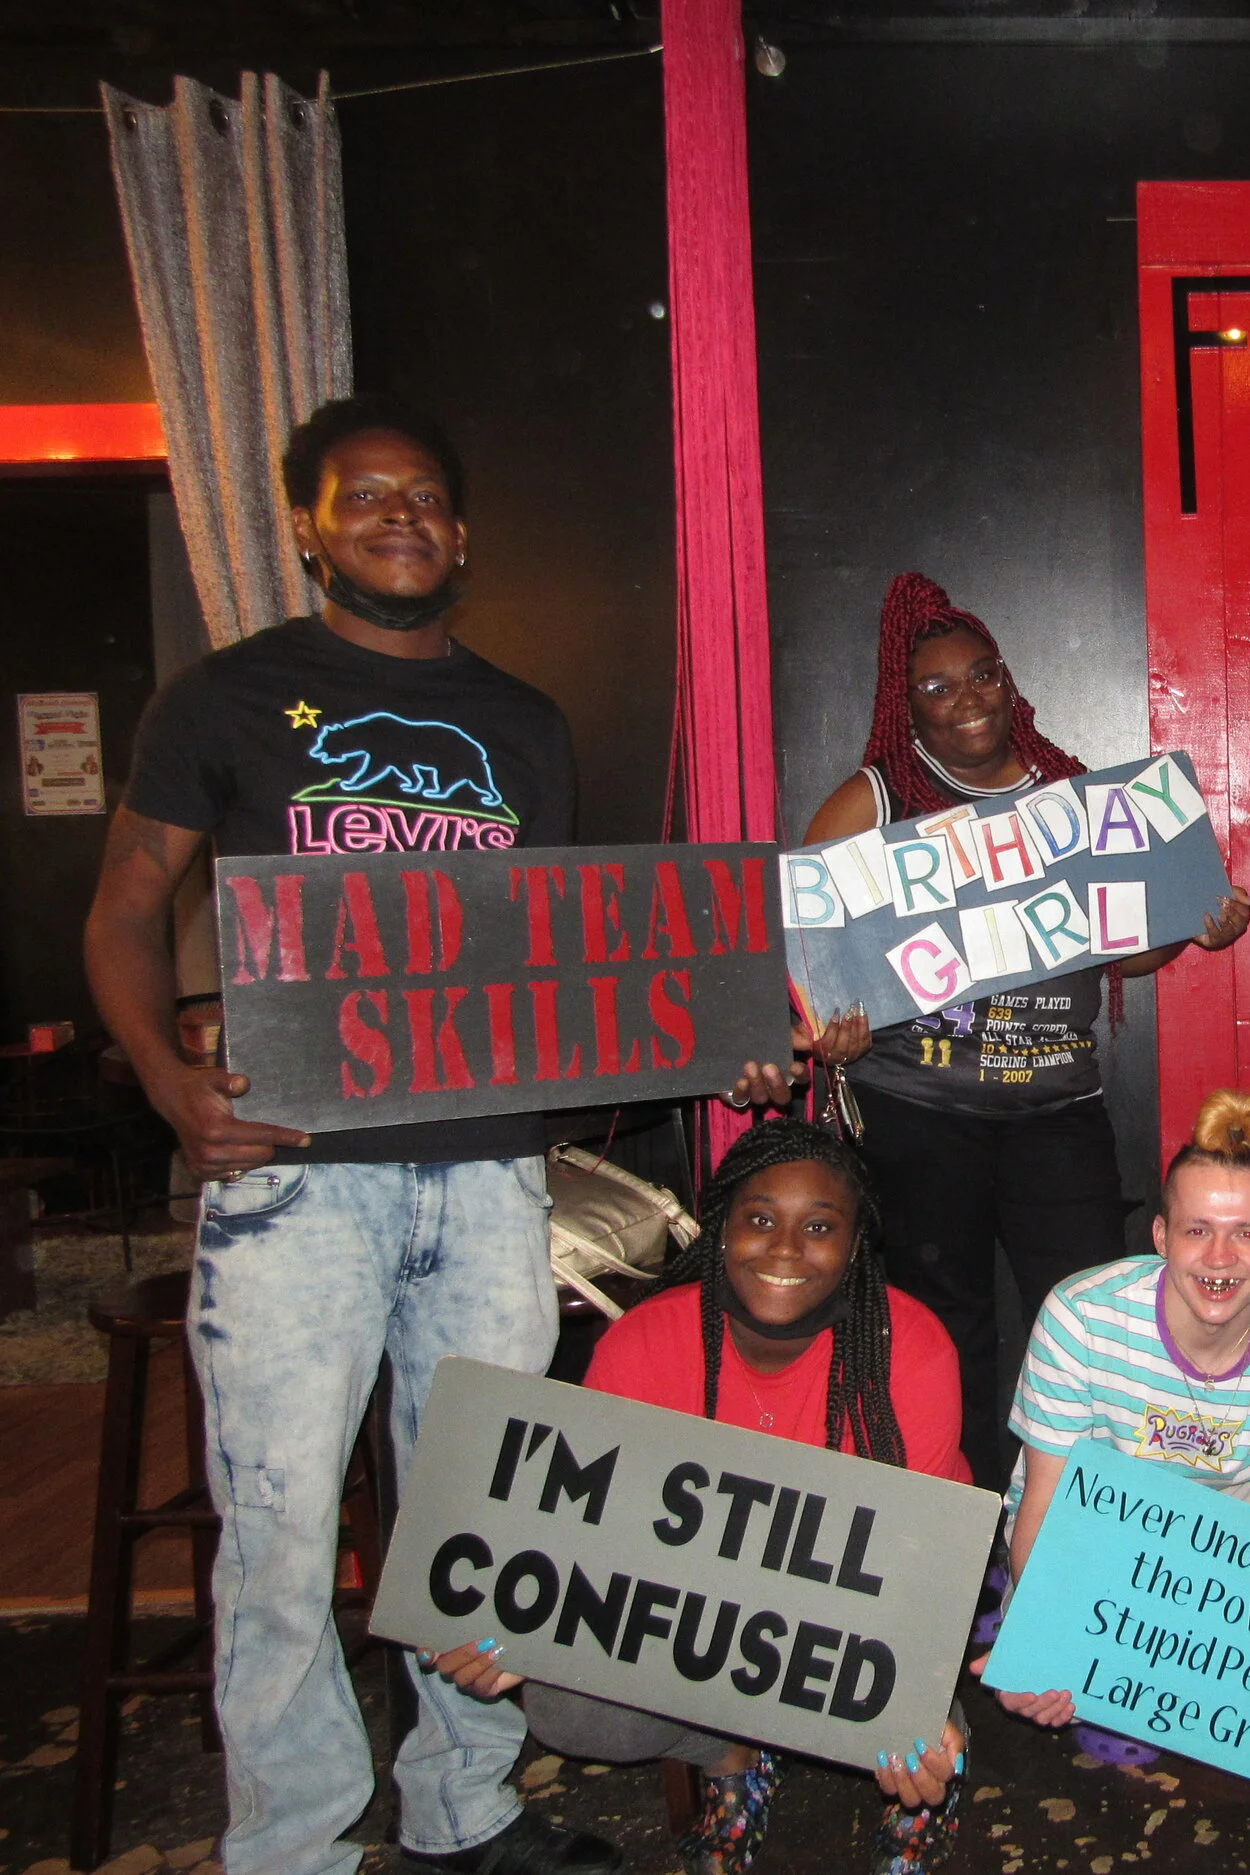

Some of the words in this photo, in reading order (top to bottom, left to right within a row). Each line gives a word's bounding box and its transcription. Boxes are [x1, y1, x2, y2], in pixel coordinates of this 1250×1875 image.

[788, 762, 1189, 926] BIRTHDAY
[225, 870, 464, 985] MAD
[509, 858, 771, 966] TEAM
[900, 887, 1139, 1002] GIRL
[339, 968, 697, 1099] SKILLS
[985, 1019, 1027, 1032] POINTS
[988, 1008, 1013, 1020] 639
[990, 995, 1029, 1008] GAMES
[1034, 996, 1072, 1010] PLAYED
[1005, 1033, 1033, 1046] STAR
[979, 1054, 1028, 1069] SCORING
[1033, 1051, 1075, 1068] CHAMPION
[981, 1043, 995, 1055] 10
[1002, 1069, 1034, 1083] 2007
[488, 1417, 621, 1526] I'M
[652, 1461, 884, 1597] STILL
[1064, 1466, 1186, 1540] Never
[1129, 1551, 1194, 1606] the
[429, 1532, 897, 1723] CONFUSED
[1085, 1598, 1217, 1675] Stupid
[1081, 1658, 1202, 1733] Large
